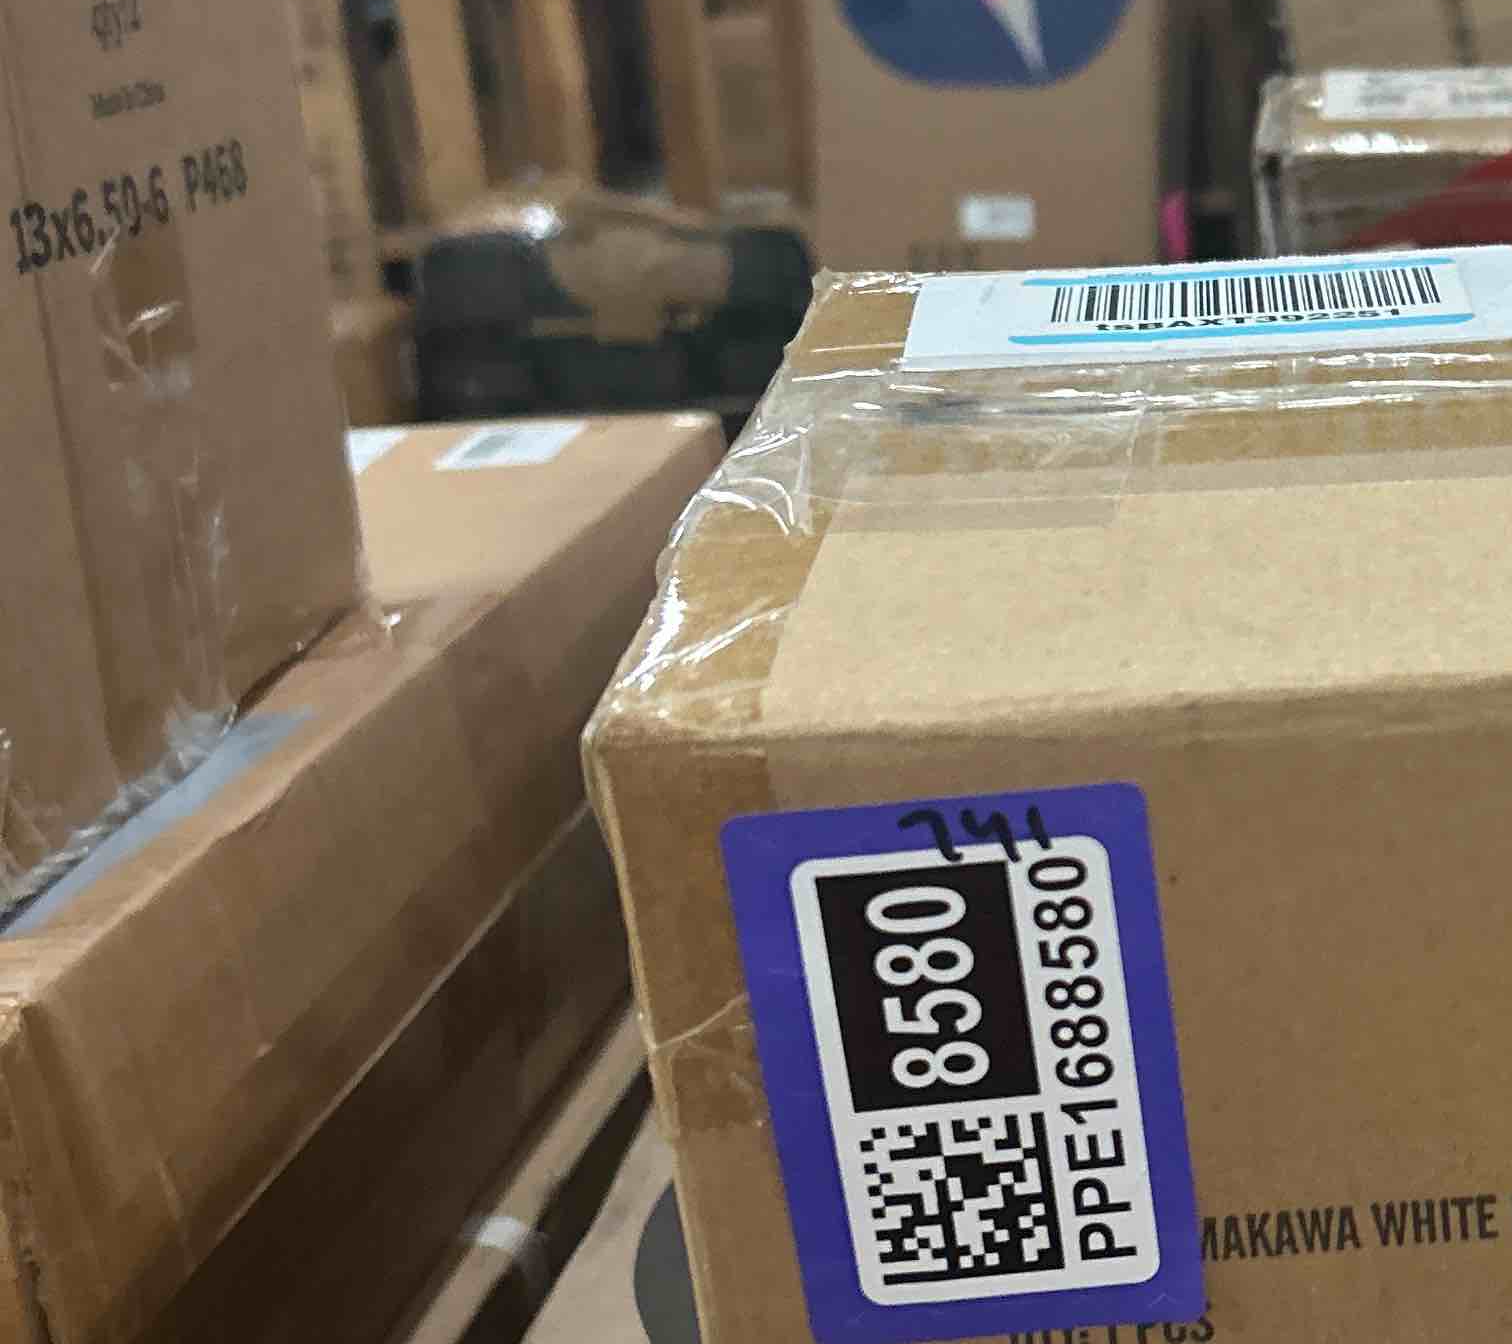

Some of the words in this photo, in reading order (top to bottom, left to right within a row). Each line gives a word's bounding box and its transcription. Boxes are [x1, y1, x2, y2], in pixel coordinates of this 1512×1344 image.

[864, 885, 990, 1089] 8580
[1027, 855, 1138, 1261] PPE1688580
[1371, 1194, 1499, 1247] WHITE
